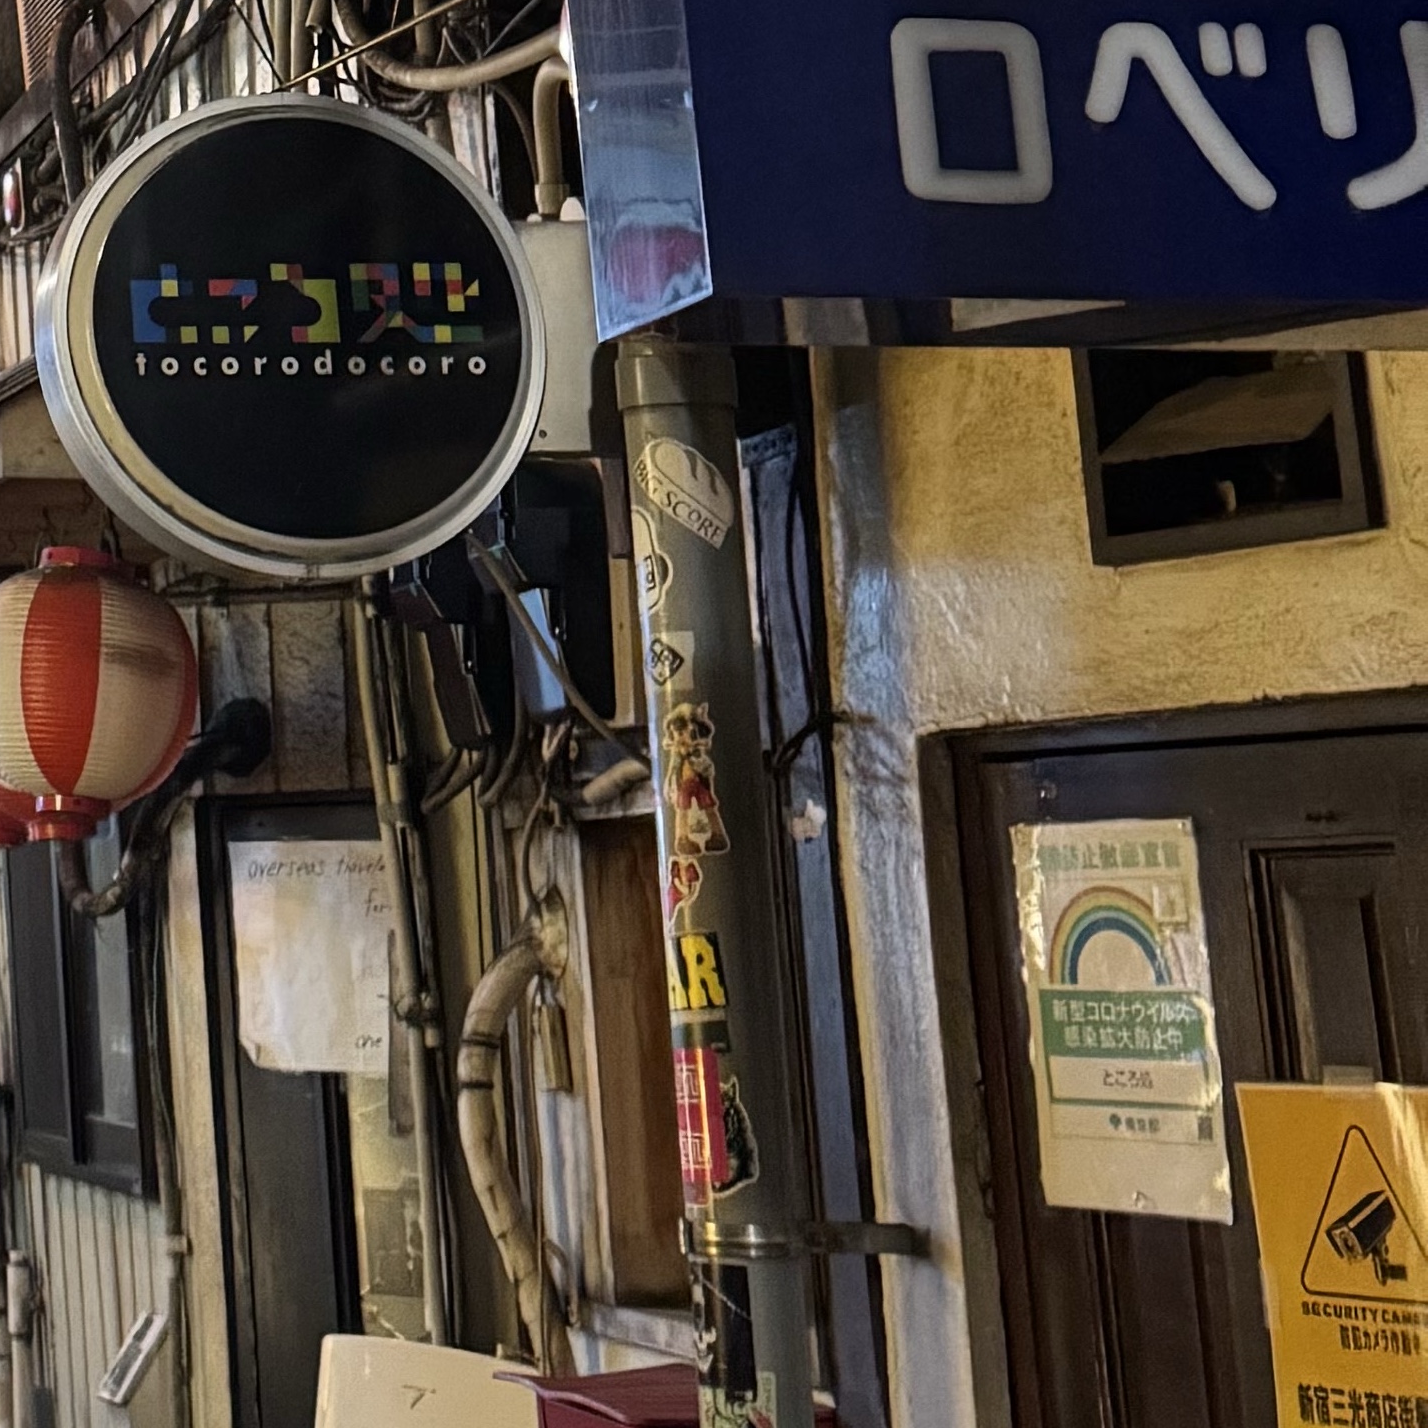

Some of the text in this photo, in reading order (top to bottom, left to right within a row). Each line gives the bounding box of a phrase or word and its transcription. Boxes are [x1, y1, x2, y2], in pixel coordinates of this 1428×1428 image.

[890, 16, 1428, 212] ロベリ
[135, 348, 487, 376] tocorodocoro
[663, 488, 722, 543] SCORE
[1301, 1300, 1379, 1324] SECURITY
